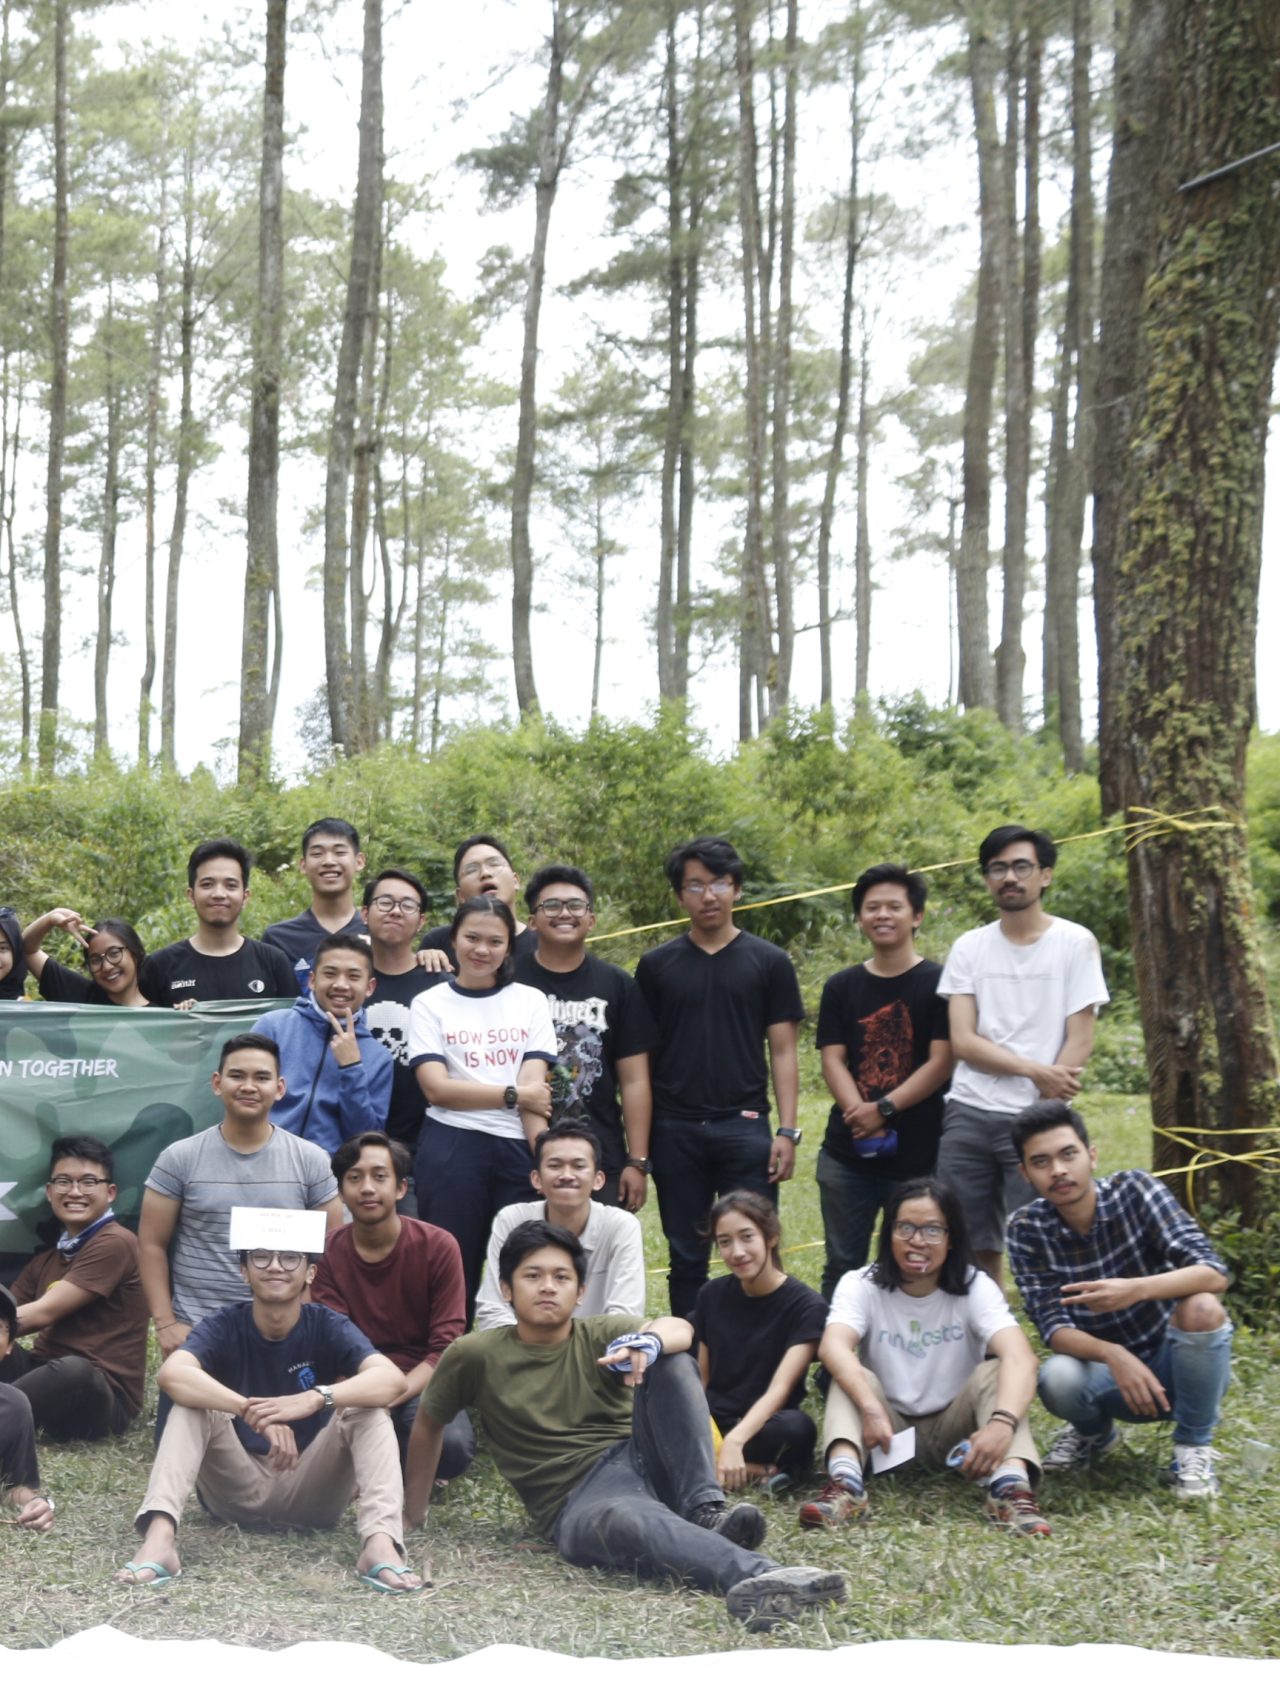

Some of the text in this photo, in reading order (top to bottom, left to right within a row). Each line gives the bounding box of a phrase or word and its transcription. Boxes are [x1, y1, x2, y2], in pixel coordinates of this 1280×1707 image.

[446, 1027, 528, 1045] HOW SOON
[464, 1047, 519, 1068] IS NOW
[18, 1059, 119, 1078] TOGETHER
